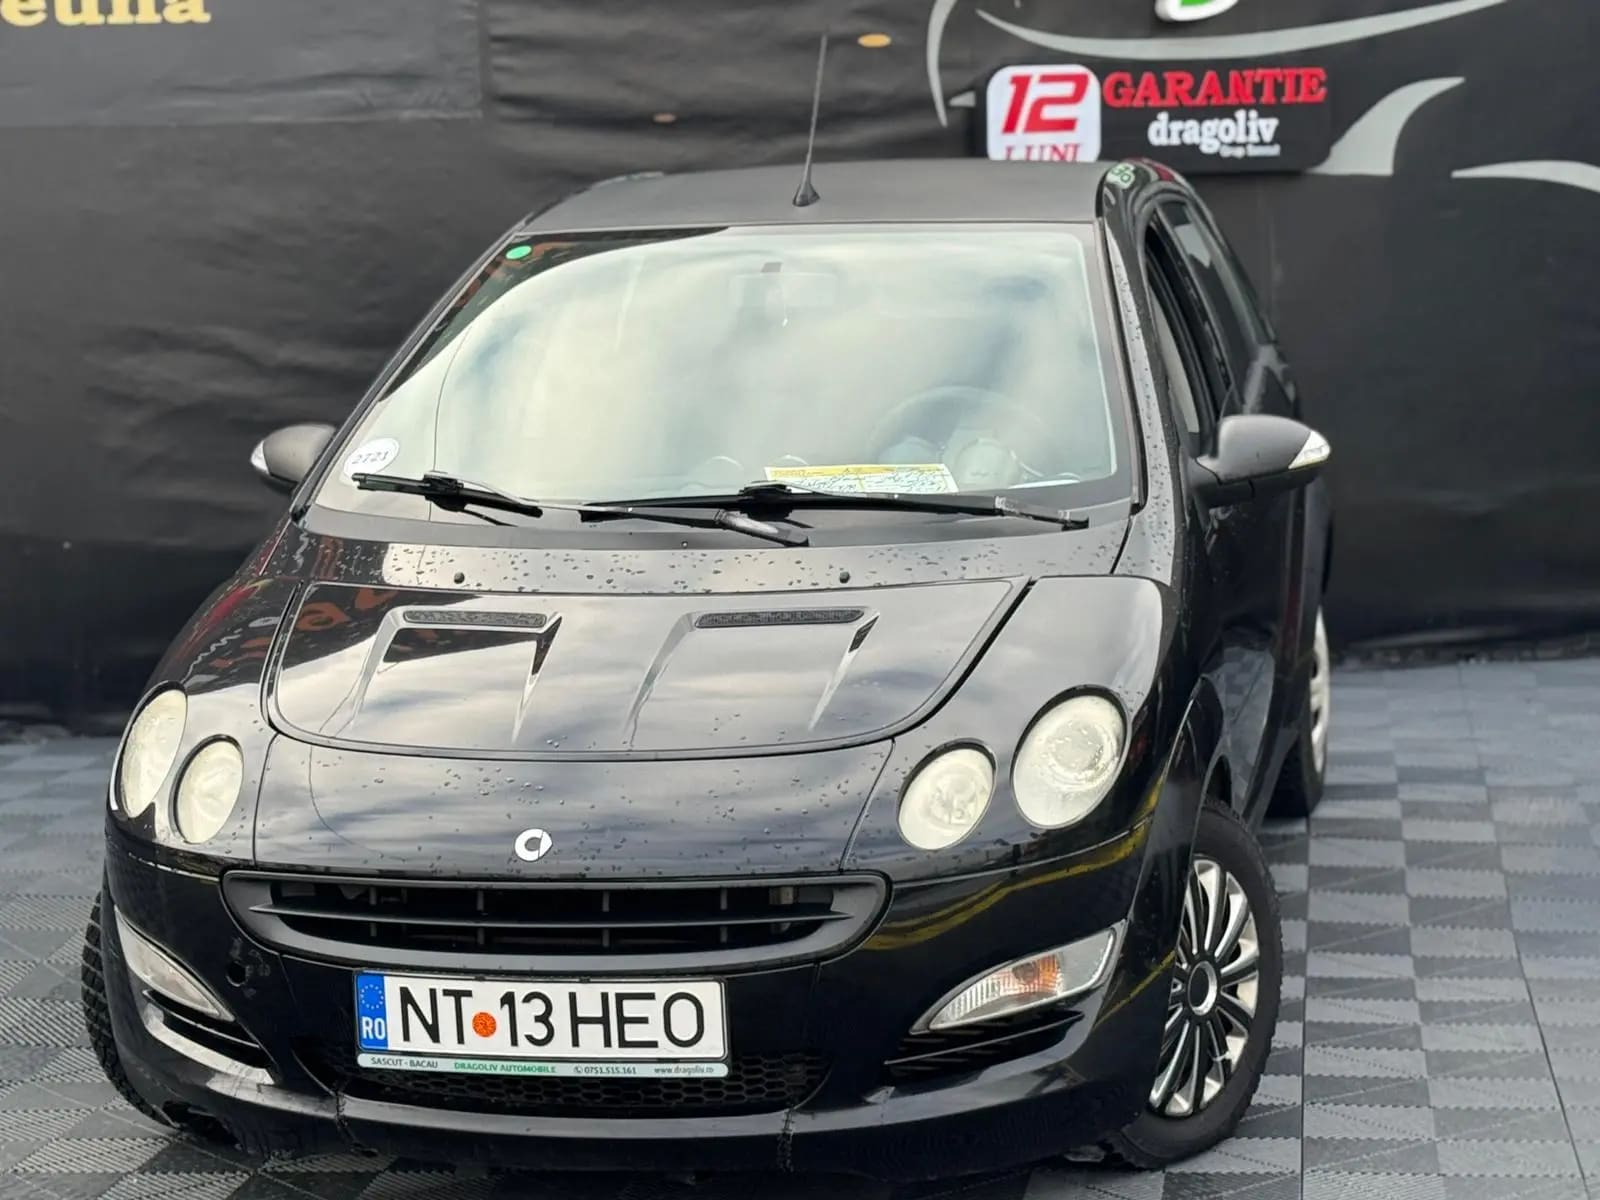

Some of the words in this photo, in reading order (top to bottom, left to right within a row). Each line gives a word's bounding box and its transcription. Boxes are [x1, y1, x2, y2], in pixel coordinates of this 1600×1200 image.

[1002, 73, 1090, 134] 12
[1102, 68, 1328, 107] GARANTIE
[1148, 109, 1279, 155] dragoliv
[361, 1017, 386, 1040] RO
[399, 986, 473, 1045] NT
[500, 990, 555, 1047] 13
[568, 991, 705, 1049] HEO
[370, 1057, 402, 1067] SASCUT
[454, 1061, 498, 1073] DRAGOLIV
[500, 1063, 556, 1074] AUTOMOBILE
